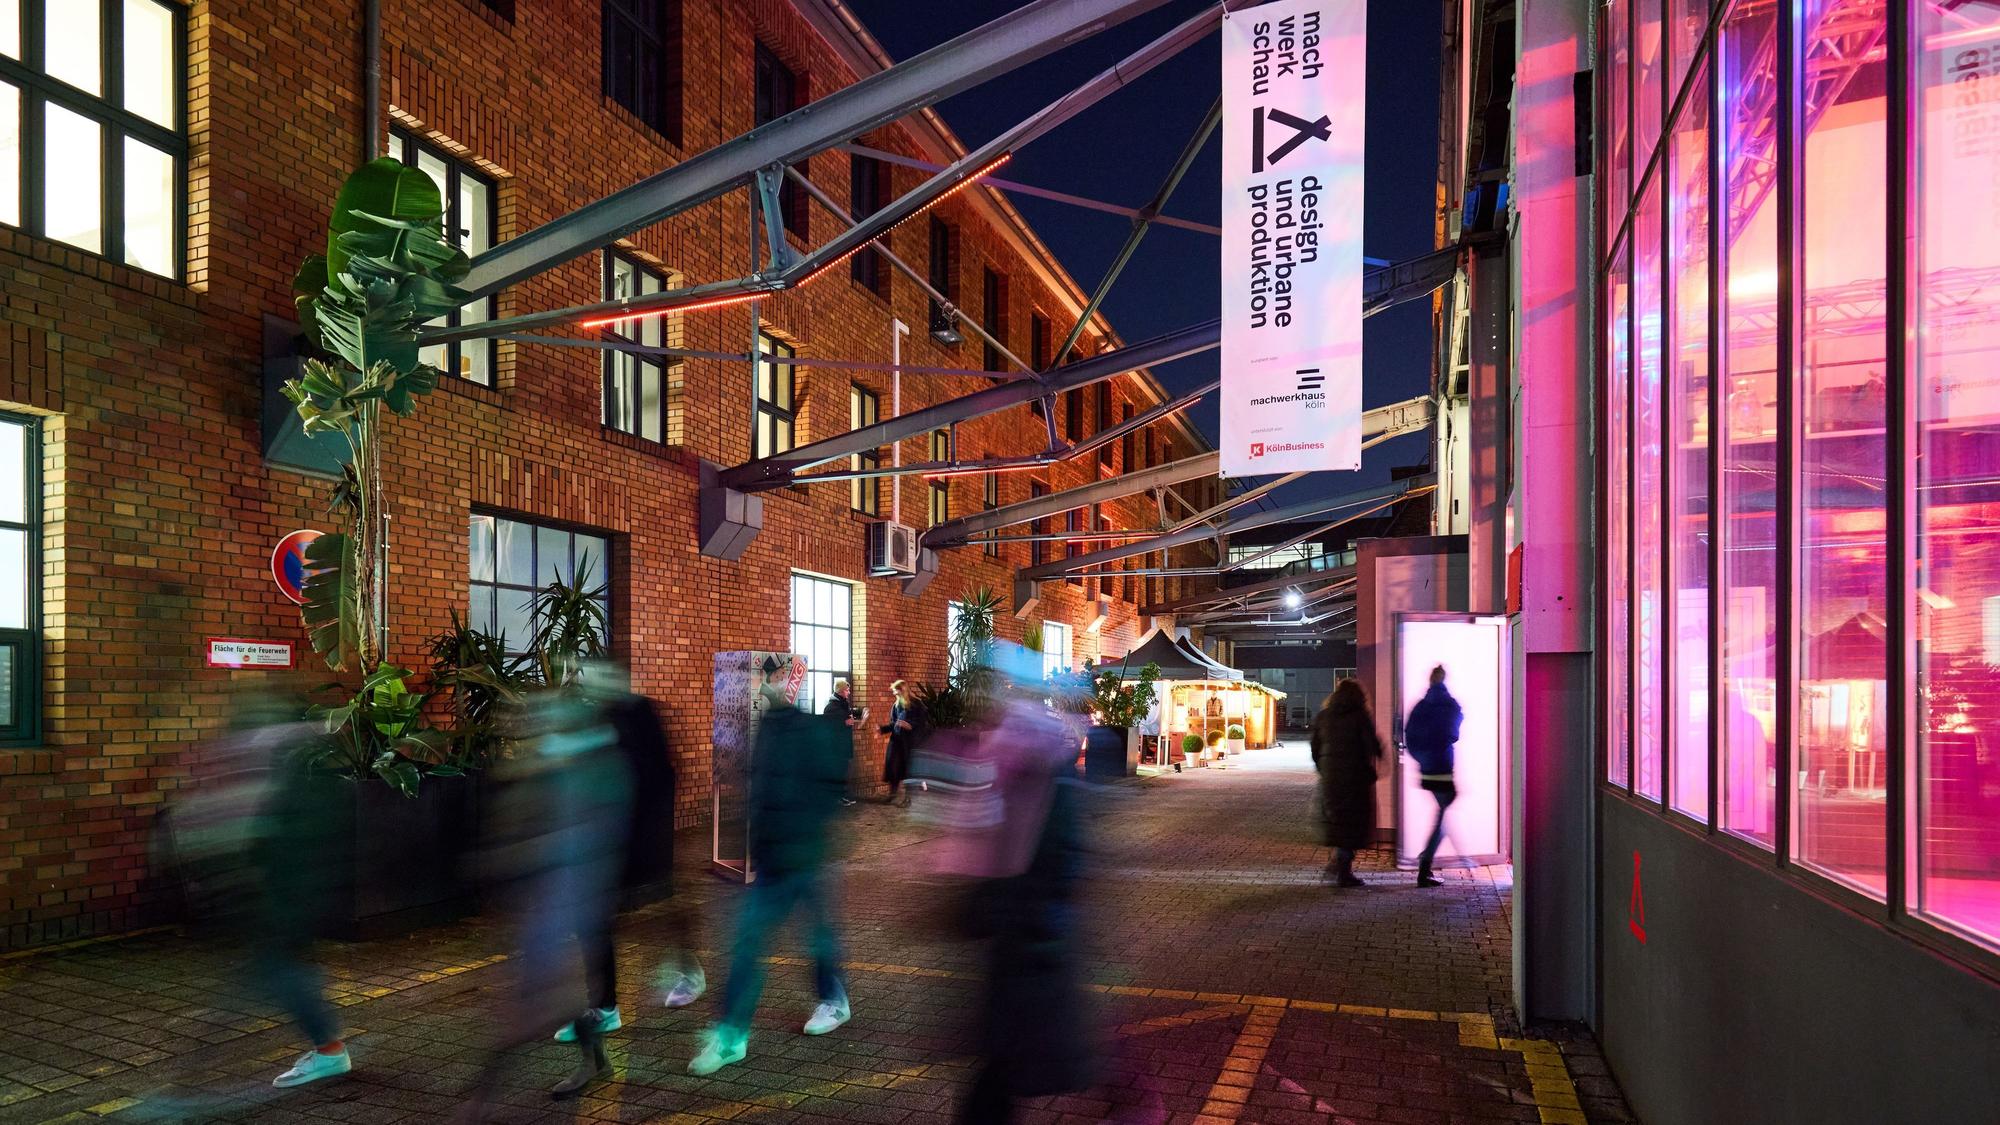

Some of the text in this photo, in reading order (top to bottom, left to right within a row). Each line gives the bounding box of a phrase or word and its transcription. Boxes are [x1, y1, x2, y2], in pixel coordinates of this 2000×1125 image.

[1252, 21, 1274, 96] schau
[1277, 15, 1299, 78] werk
[1302, 11, 1324, 79] mach
[1295, 175, 1324, 263] design
[1247, 184, 1272, 329] produktion
[1275, 179, 1297, 327] und urbane
[1250, 392, 1326, 406] machwerkhaus
[1305, 400, 1326, 409] köln
[1266, 442, 1325, 453] KölnBusiness
[214, 644, 234, 653] Fläche
[236, 645, 245, 653] für
[258, 646, 288, 655] Feuerwehr
